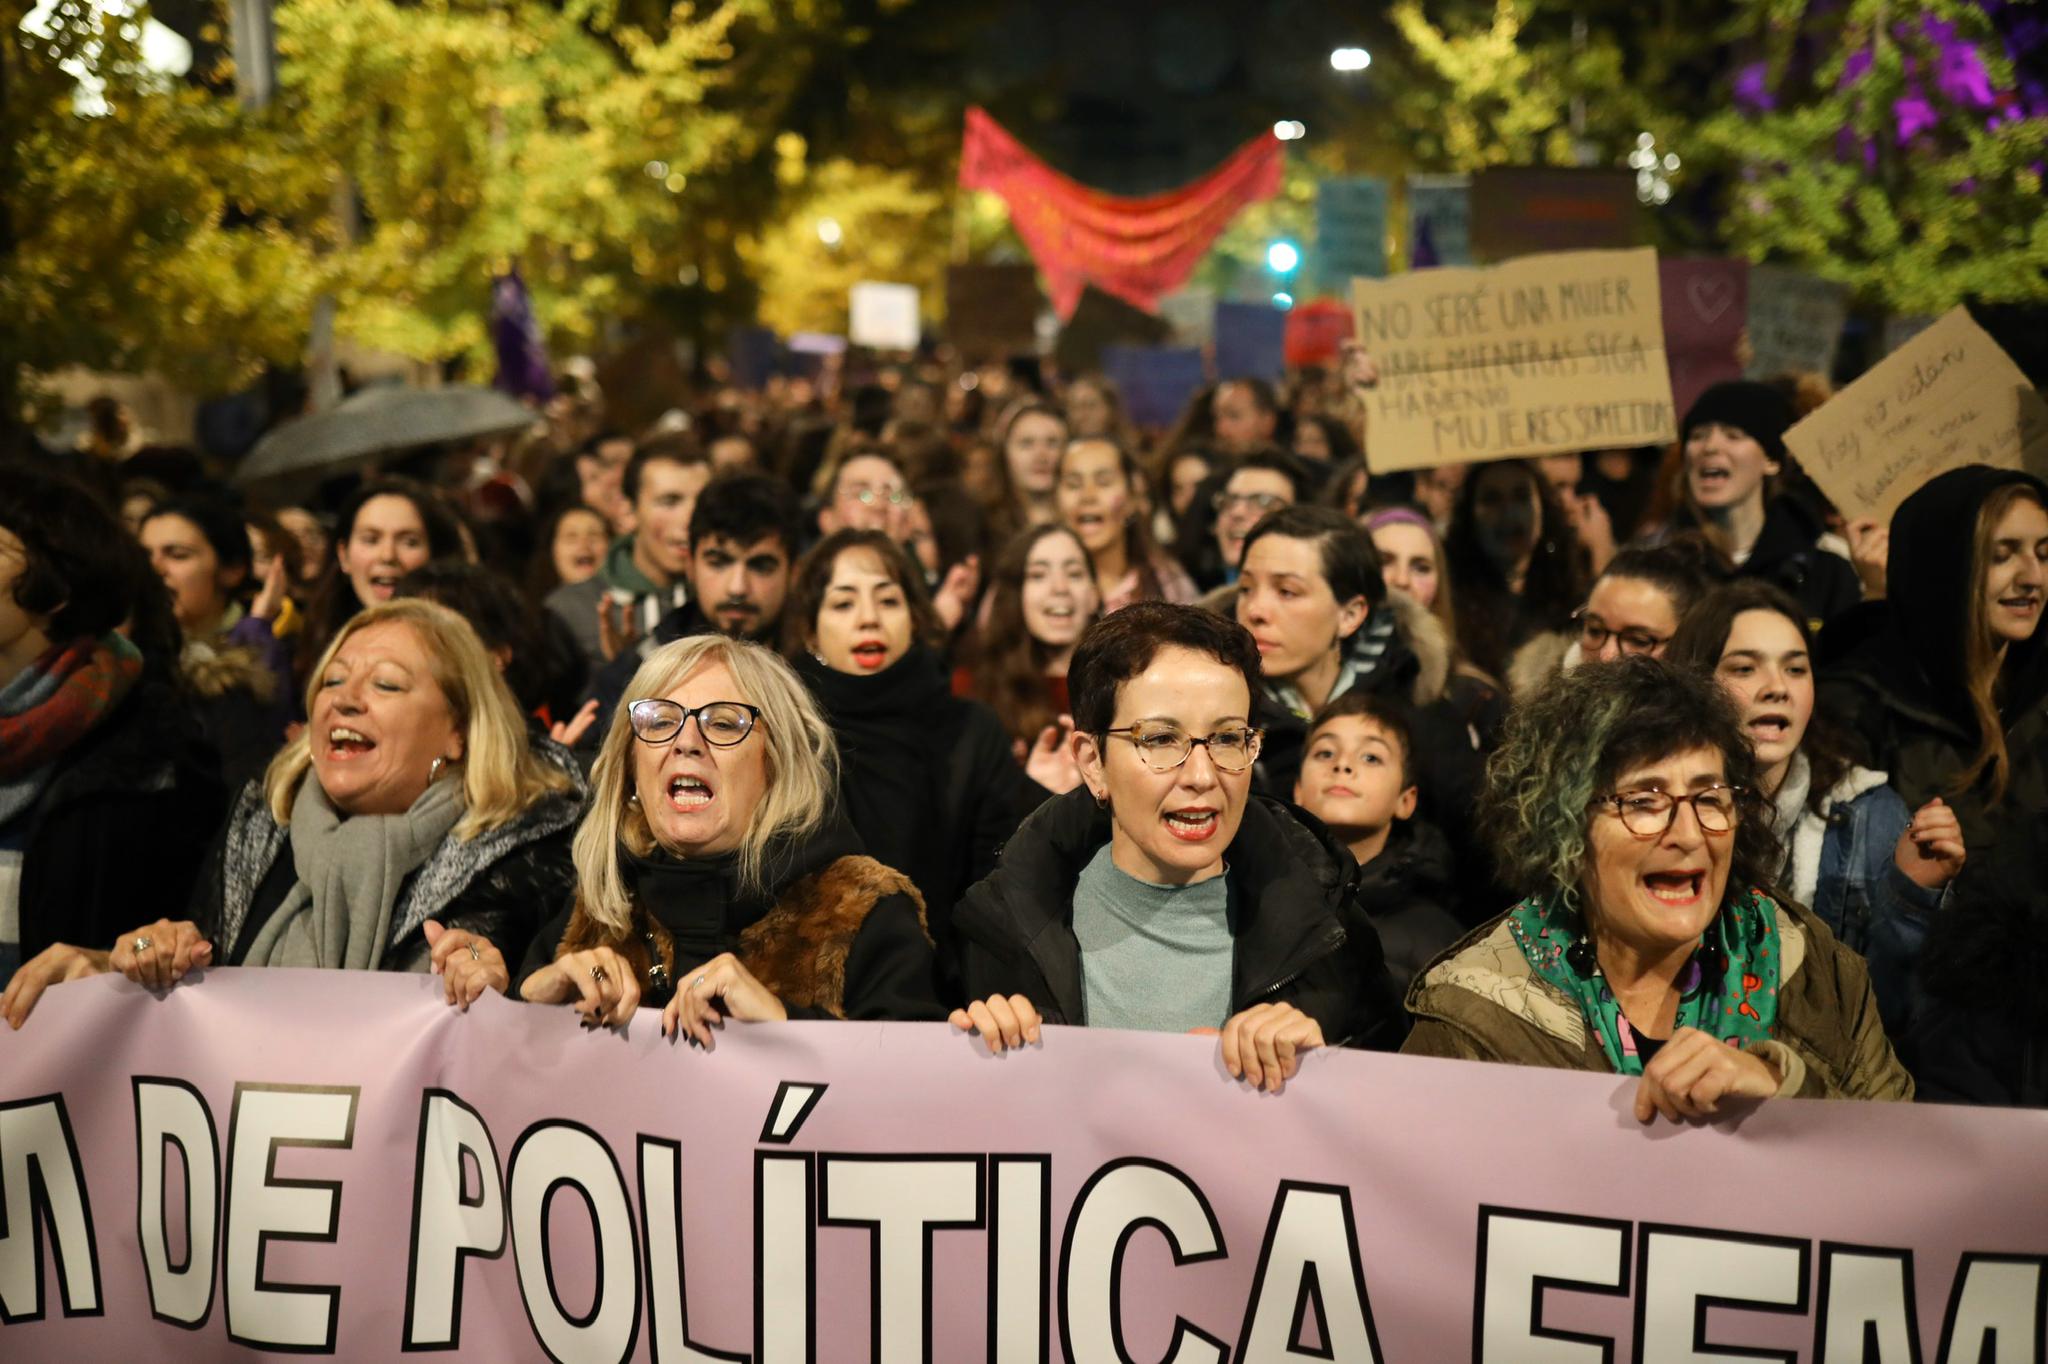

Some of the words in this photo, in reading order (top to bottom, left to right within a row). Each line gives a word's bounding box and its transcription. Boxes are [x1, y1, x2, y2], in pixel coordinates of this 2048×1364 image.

[1361, 302, 1413, 345] NO
[1424, 283, 1490, 338] SERÉ
[1500, 284, 1552, 328] UNA
[1558, 277, 1636, 322] MUJER
[1586, 330, 1649, 376] SIGA
[131, 1075, 361, 1354] DE
[402, 1080, 1385, 1364] POLÍTICA
